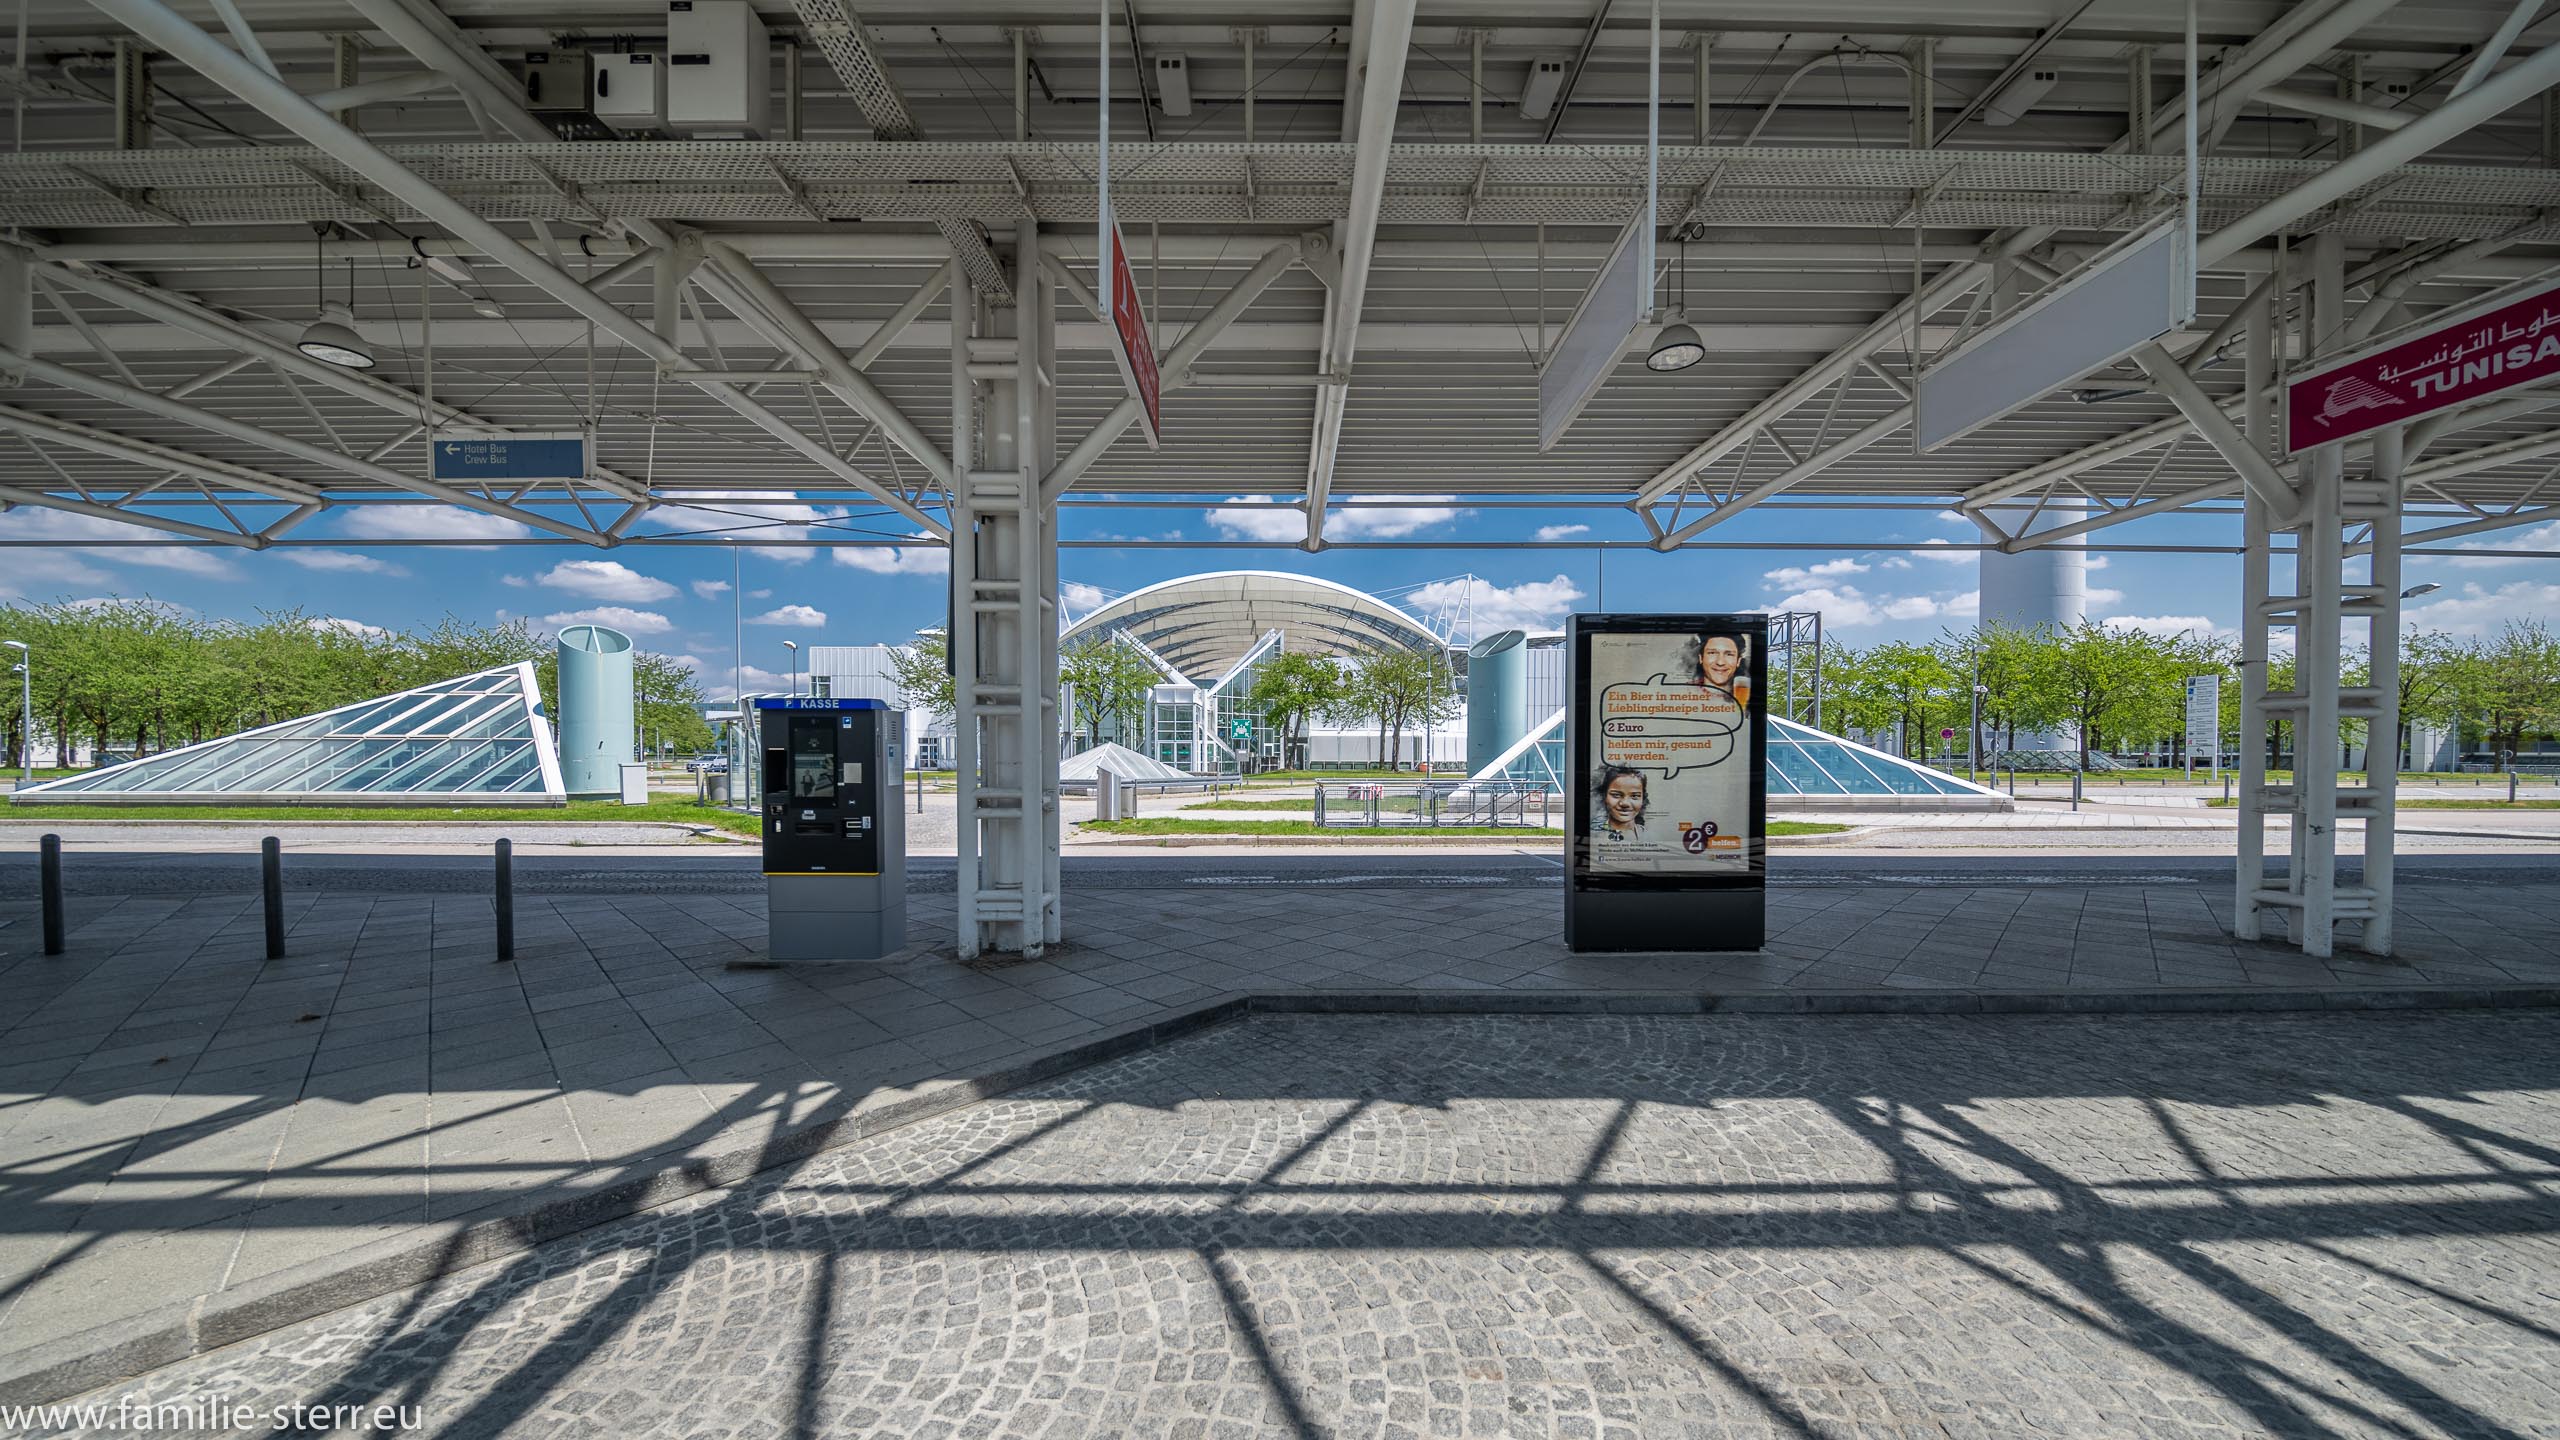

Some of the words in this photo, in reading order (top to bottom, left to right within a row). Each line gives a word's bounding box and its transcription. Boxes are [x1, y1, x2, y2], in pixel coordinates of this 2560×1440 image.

[2378, 327, 2493, 385] التونسية
[464, 443, 487, 454] Hotel
[490, 443, 507, 454] Bus
[464, 455, 488, 464] Crew
[490, 455, 507, 464] Bus
[1608, 691, 1627, 701] Ein
[1630, 691, 1652, 701] Bier
[1656, 691, 1667, 701] in
[1670, 691, 1712, 701] meiner
[800, 699, 840, 709] KASSE
[1608, 703, 1699, 715] Lieblingskneipe
[1701, 703, 1736, 713] kostet
[1607, 723, 1615, 732] 2
[1617, 723, 1644, 732] Euro
[1608, 739, 1642, 749] helfen
[1645, 739, 1669, 751] mir,
[1671, 739, 1712, 752] gesund
[1608, 753, 1621, 761] zu
[1624, 752, 1669, 761] werden.
[1688, 829, 1702, 851] 2
